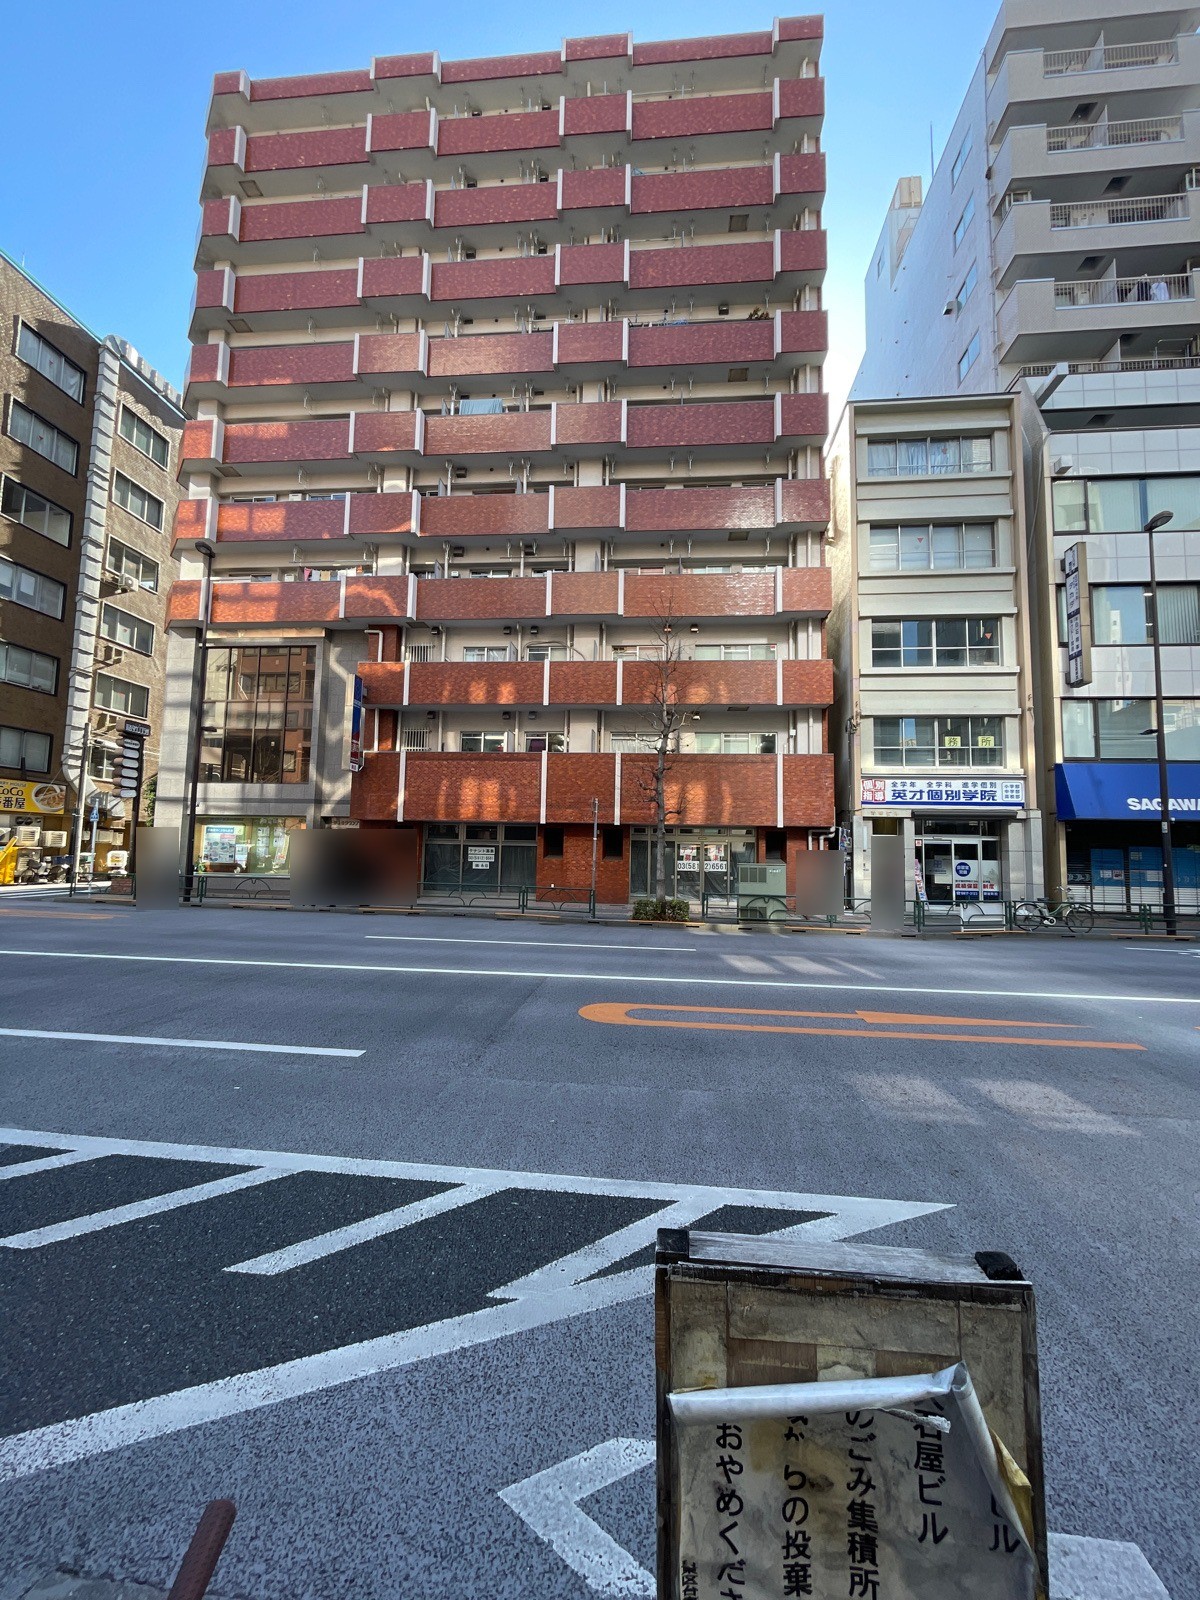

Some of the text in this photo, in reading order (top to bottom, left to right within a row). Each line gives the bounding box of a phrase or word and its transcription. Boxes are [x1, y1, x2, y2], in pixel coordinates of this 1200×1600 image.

[947, 737, 992, 747] 務 所
[961, 781, 997, 789] 進学個別
[891, 789, 998, 801] 英才個別学院
[0, 796, 26, 809] 番屋
[1126, 797, 1200, 811] SAGAW
